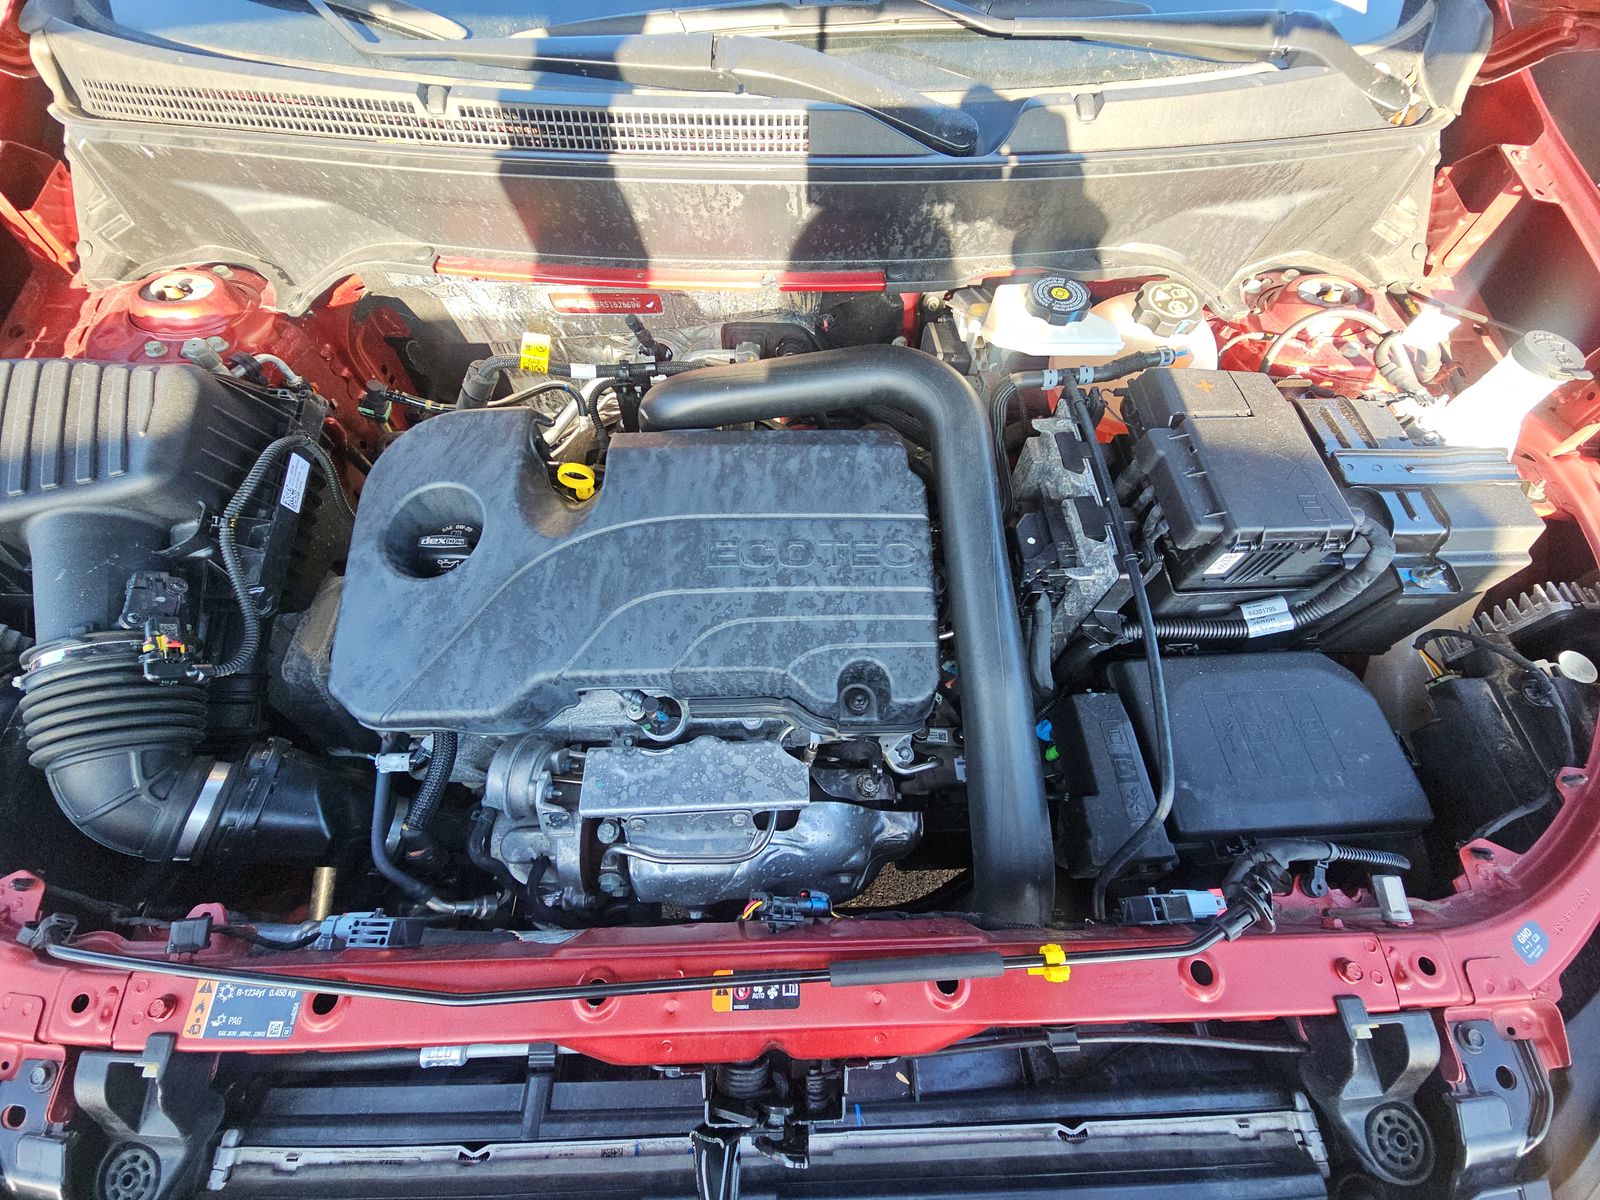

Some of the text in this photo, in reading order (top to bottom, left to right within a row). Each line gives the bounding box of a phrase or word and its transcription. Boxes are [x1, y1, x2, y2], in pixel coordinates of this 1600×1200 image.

[707, 539, 916, 568] ECOTEC
[1517, 927, 1533, 945] GND
[236, 988, 297, 999] R-1234yf 0.450 kg
[751, 992, 765, 1000] AUTO
[227, 1016, 242, 1025] PAG
